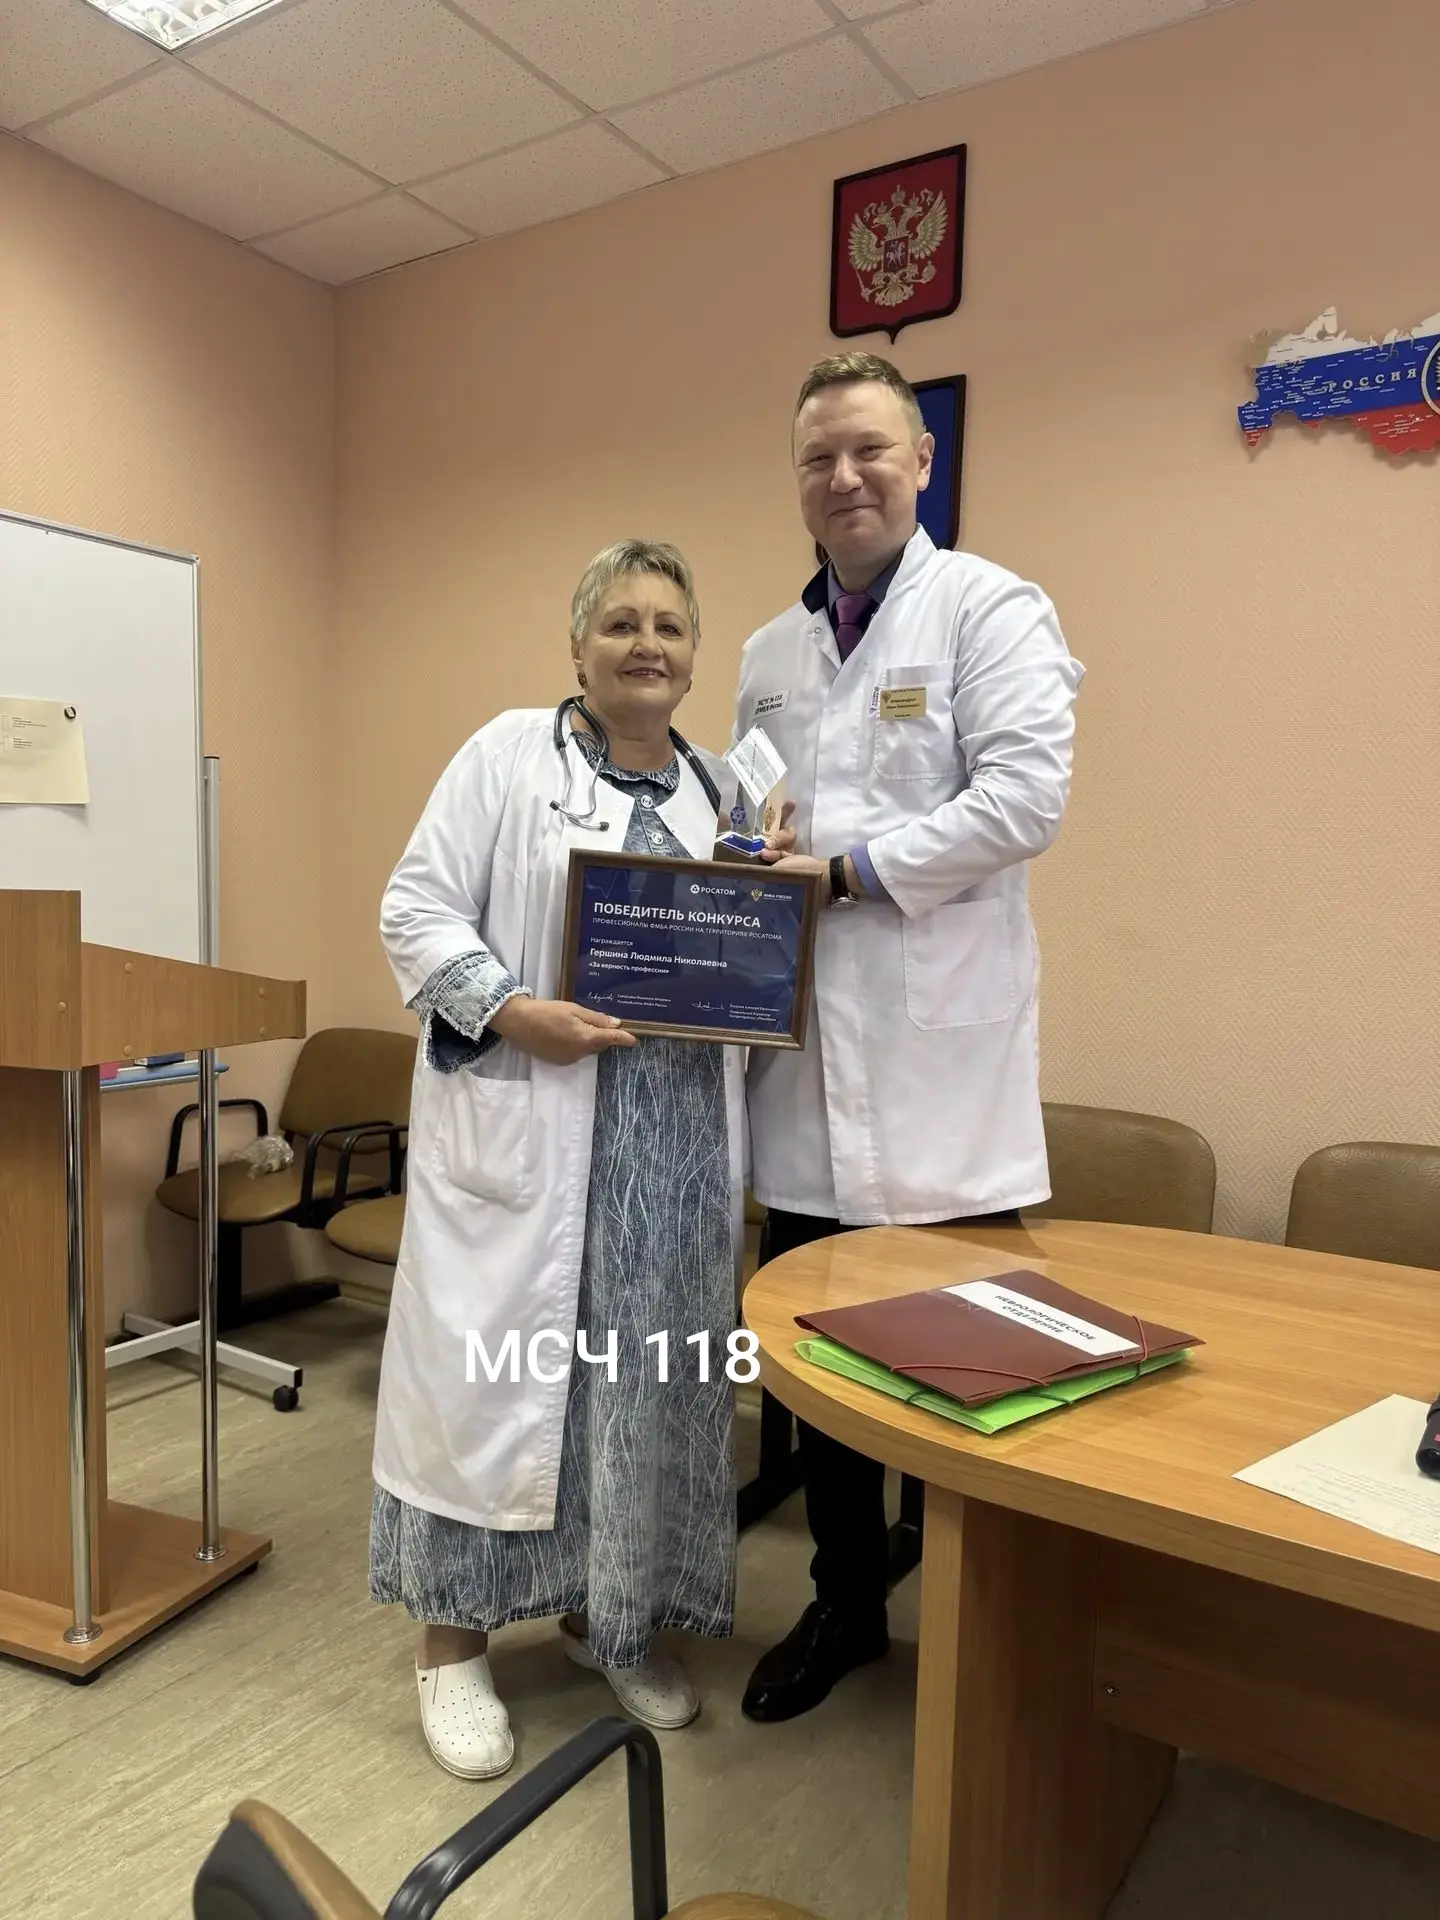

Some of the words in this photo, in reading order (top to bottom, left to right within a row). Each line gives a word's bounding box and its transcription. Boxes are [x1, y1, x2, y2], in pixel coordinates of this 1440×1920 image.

[1328, 368, 1417, 392] РОССИЯ
[700, 886, 736, 896] РОСАТОМ
[594, 902, 684, 921] ПОБЕДИТЕЛЬ
[688, 911, 761, 928] КОНКУРСА
[592, 917, 648, 928] ПРОФЕССИОНАЛЫ
[649, 922, 668, 930] ФМБА
[669, 924, 694, 933] РОССИИ
[705, 928, 748, 938] ТЕРРИТОРИЯХ
[749, 932, 782, 940] РОСАТОМА
[590, 936, 634, 947] Награждается
[590, 948, 628, 959] Гершина
[630, 952, 672, 963] Людмила
[674, 955, 727, 968] Николаевна
[601, 963, 630, 971] верность
[631, 966, 670, 974] профессии»
[994, 1295, 1096, 1341] НЕВРОЛОГИЧЕСКОЕ
[1001, 1305, 1064, 1333] ОТДЕЛЕНИЕ
